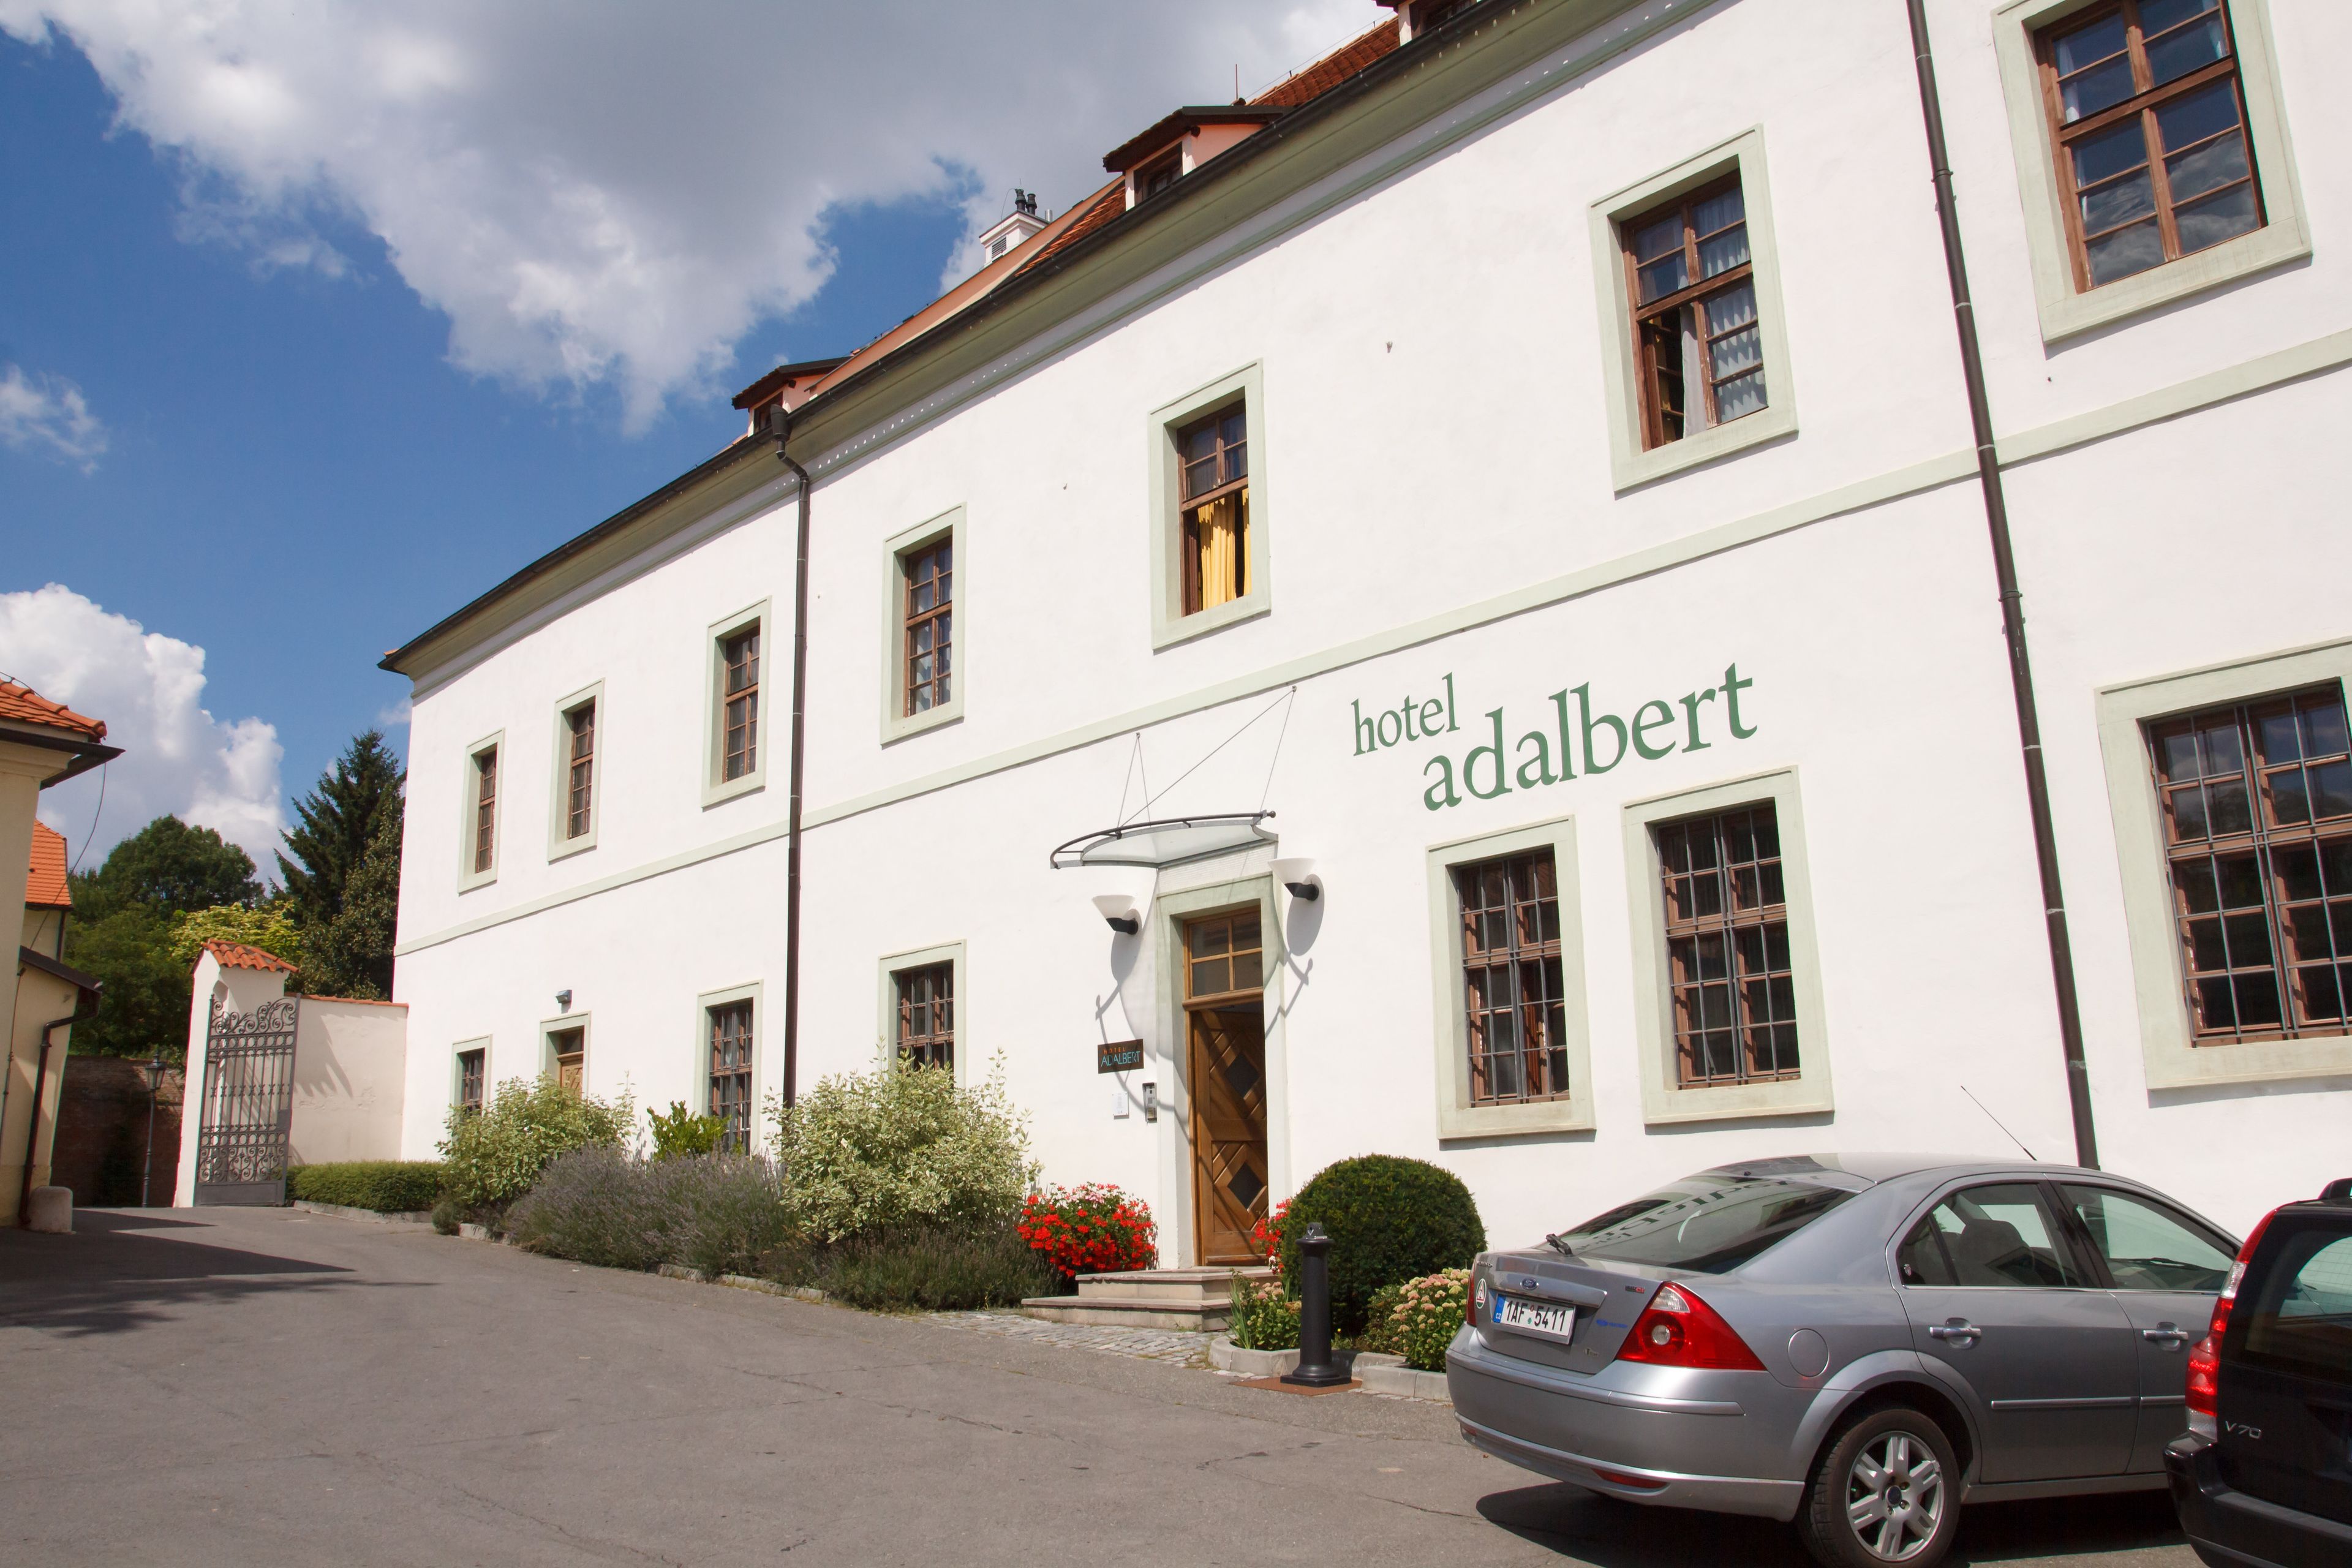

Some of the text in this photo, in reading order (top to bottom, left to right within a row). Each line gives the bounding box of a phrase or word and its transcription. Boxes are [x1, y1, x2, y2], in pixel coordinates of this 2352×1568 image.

[1351, 671, 1460, 756] hotel
[1423, 662, 1758, 811] adalbert
[1101, 1050, 1140, 1068] ADALBERT
[1102, 1046, 1126, 1055] HOTEL
[1507, 1300, 1567, 1332] 1AF 5411
[2225, 1420, 2262, 1439] V70
